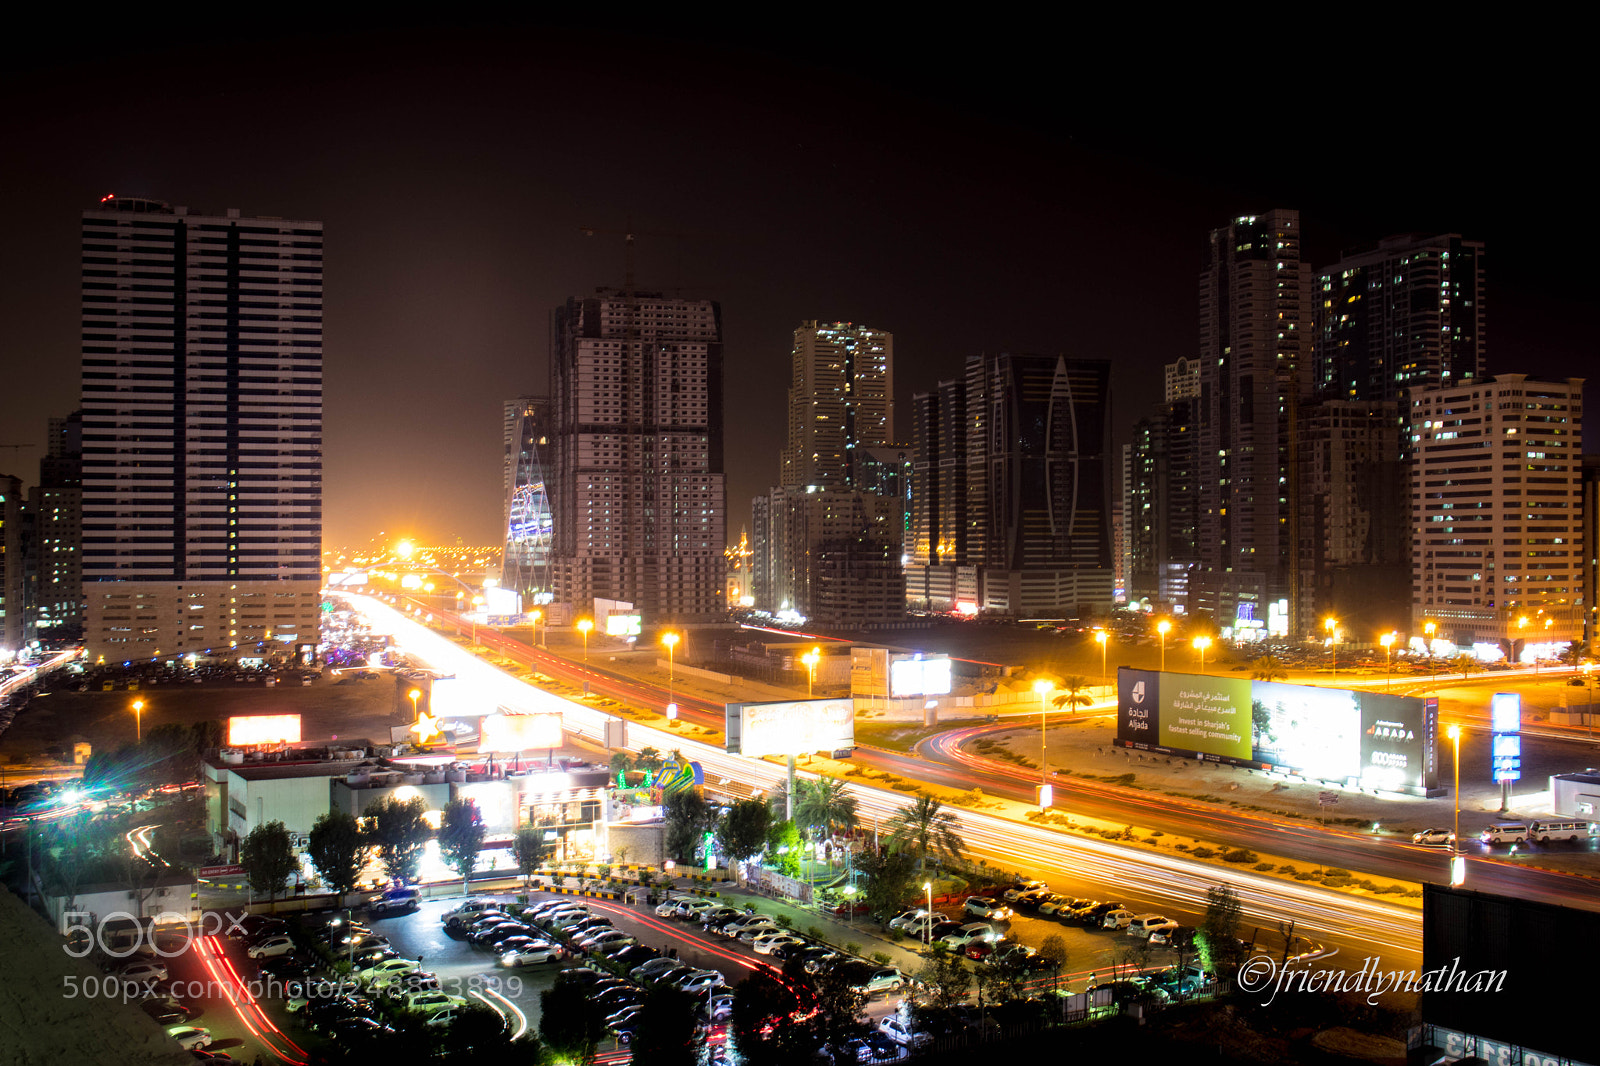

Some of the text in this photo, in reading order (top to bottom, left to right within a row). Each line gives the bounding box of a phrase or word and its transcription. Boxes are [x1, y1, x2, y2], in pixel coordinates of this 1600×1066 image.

[1179, 689, 1203, 699] المشروع
[1202, 691, 1211, 702] في
[1173, 699, 1194, 710] الشارقة
[1193, 702, 1201, 713] في
[1128, 707, 1149, 720] الجادة
[1128, 719, 1149, 731] Aljada
[1178, 716, 1230, 731] Invest in Sharjah's
[1168, 724, 1242, 744] fastest selling community
[1374, 726, 1414, 740] ARADA
